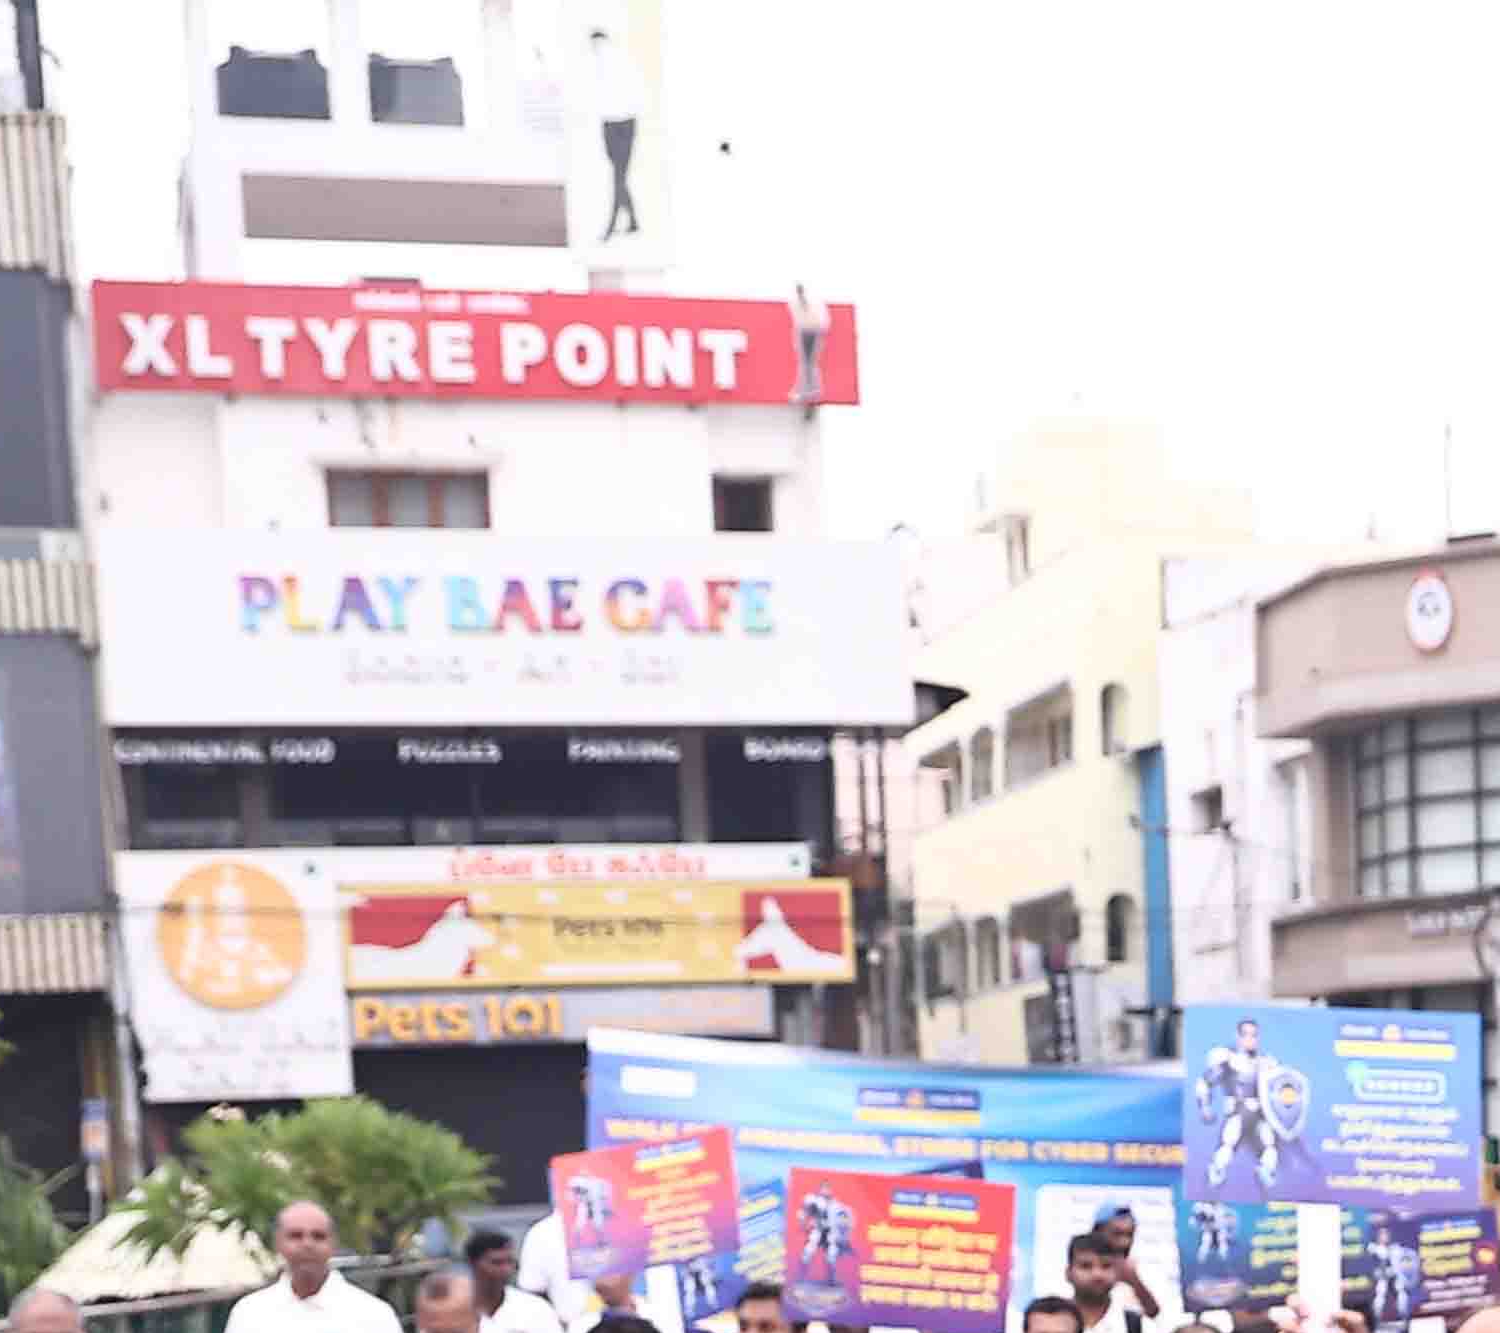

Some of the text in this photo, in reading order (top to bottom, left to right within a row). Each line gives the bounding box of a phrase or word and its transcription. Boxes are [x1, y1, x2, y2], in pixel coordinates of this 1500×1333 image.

[122, 314, 749, 390] XL TYRE POINT
[238, 574, 777, 635] PLAY BAE CAFE
[353, 994, 566, 1039] Pets 101
